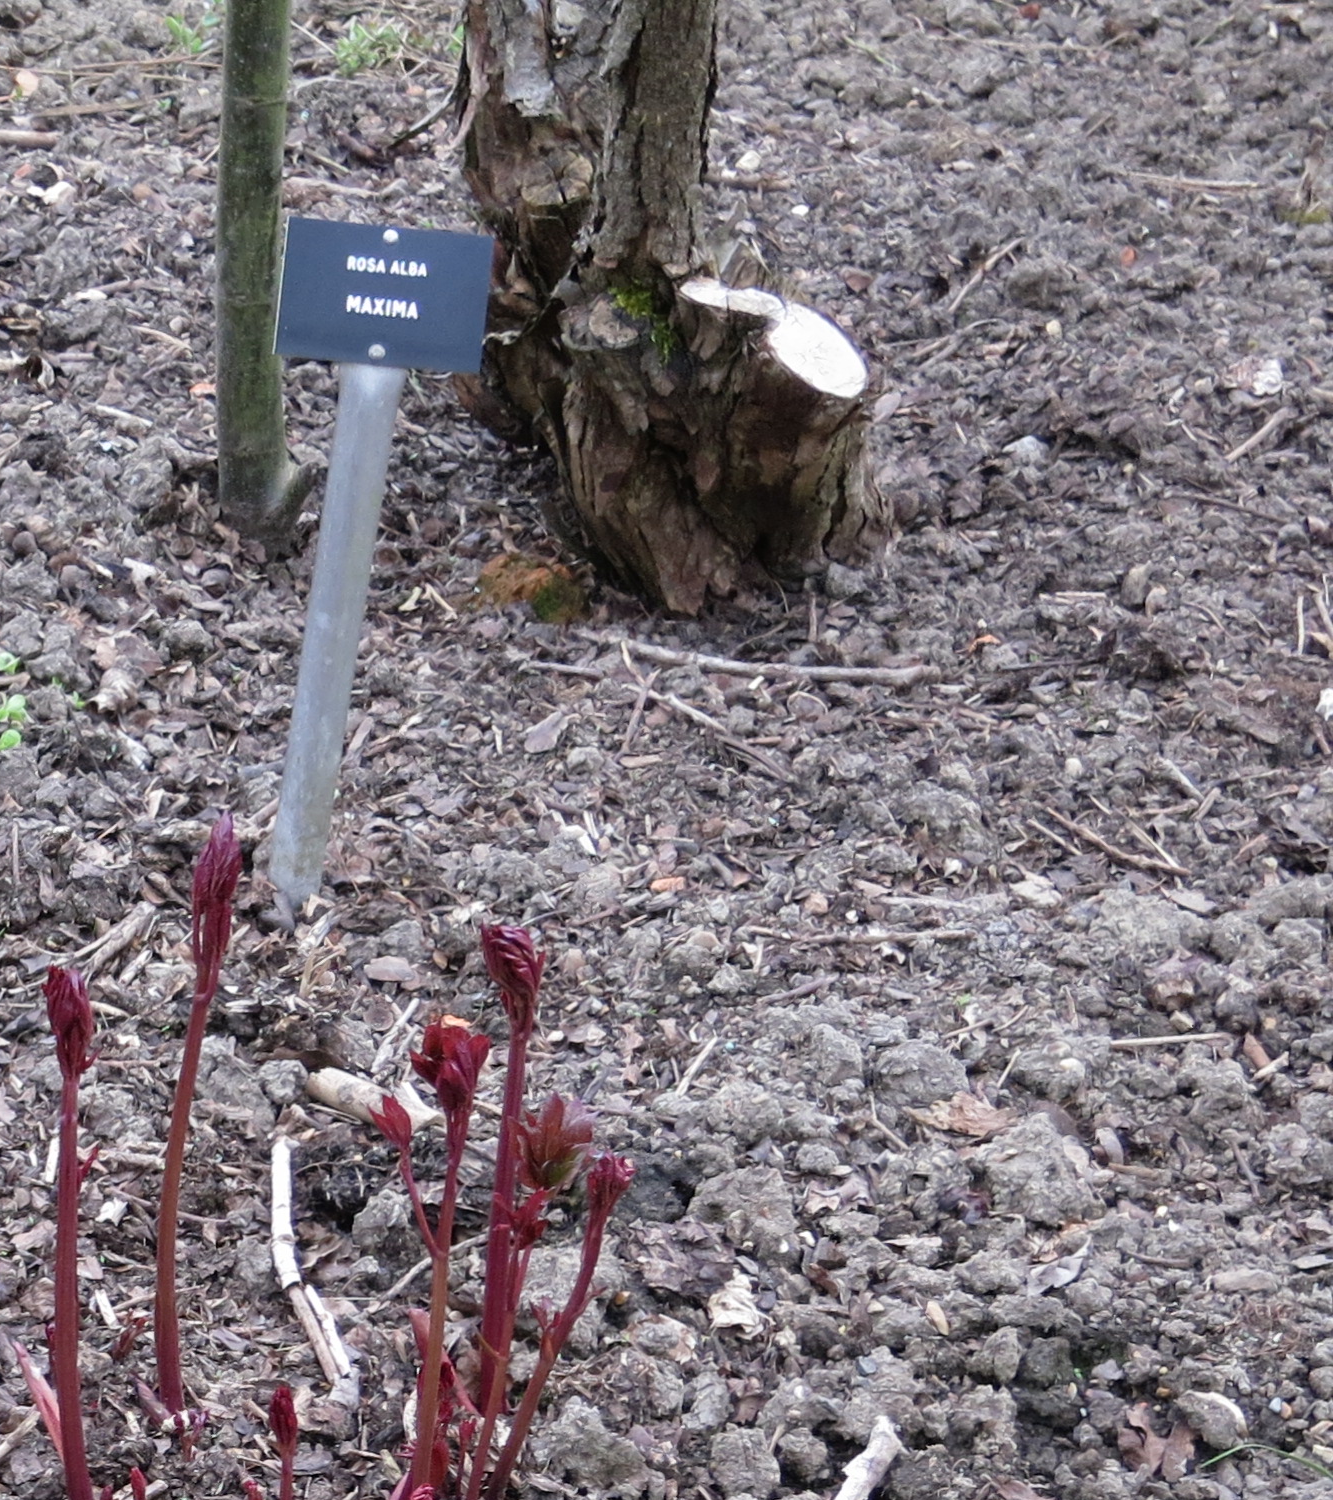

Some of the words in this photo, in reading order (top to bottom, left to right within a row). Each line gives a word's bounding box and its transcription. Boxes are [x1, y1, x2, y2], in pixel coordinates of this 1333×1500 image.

[346, 255, 386, 274] ROSA
[390, 259, 428, 278] ALBA
[345, 294, 419, 320] MAXIMA
